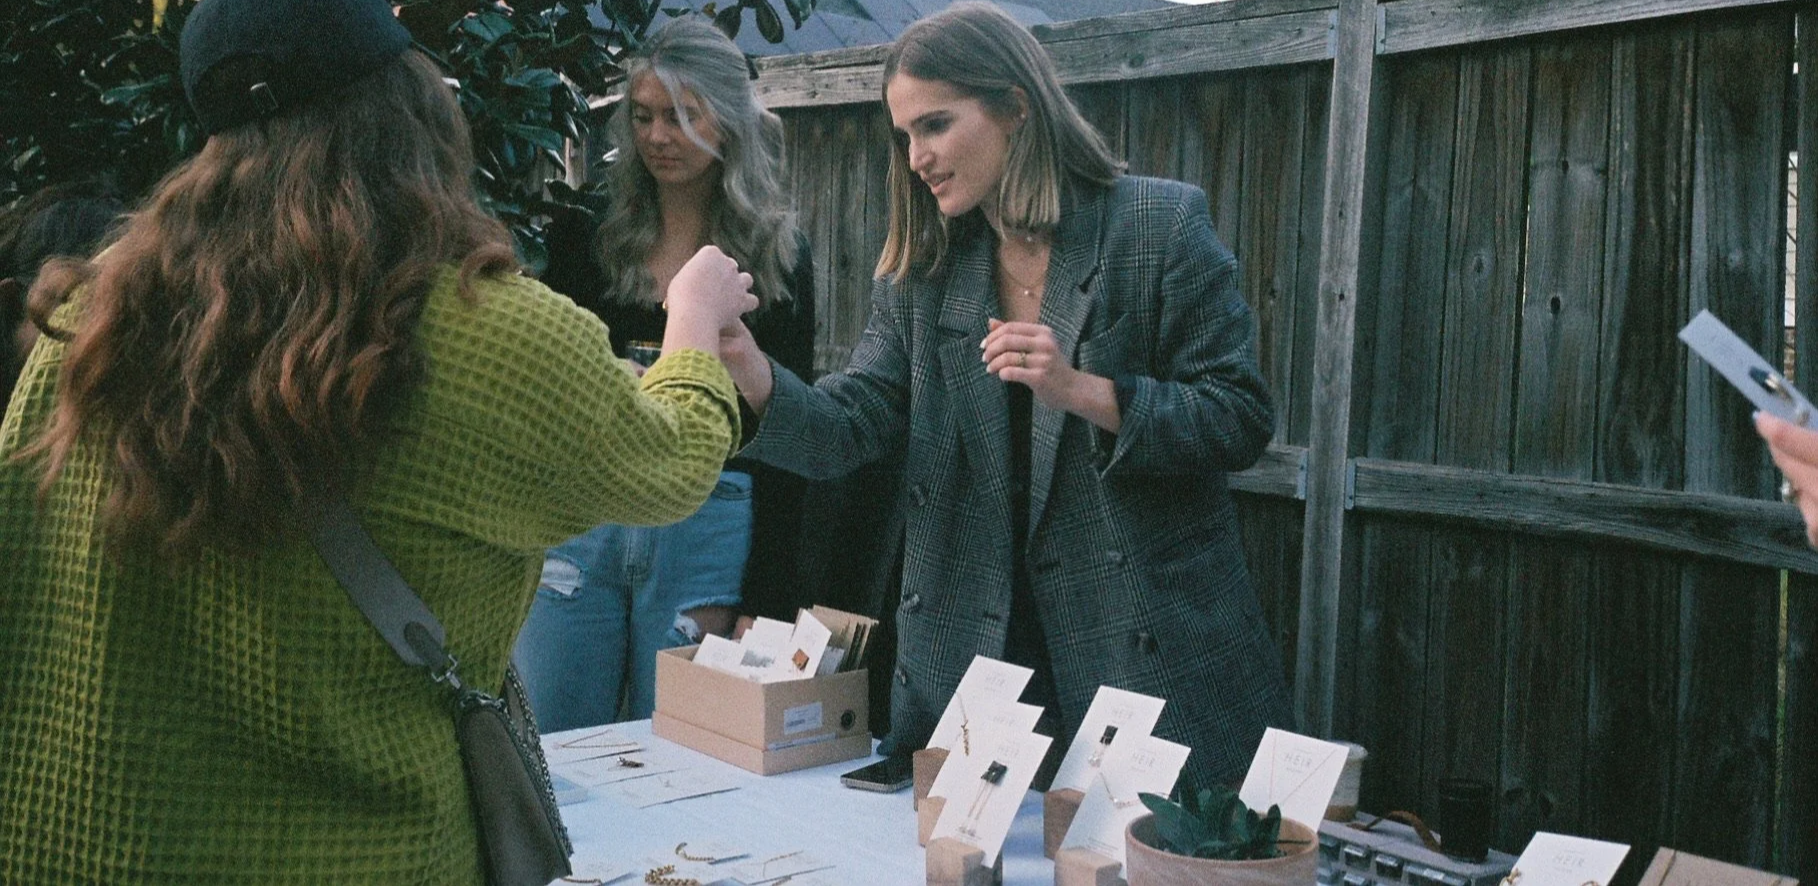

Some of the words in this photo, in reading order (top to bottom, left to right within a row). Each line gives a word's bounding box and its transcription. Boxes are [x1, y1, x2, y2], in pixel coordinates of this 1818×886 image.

[1132, 752, 1156, 768] HEIR
[1284, 753, 1312, 767] HEIR
[1552, 854, 1585, 867] HEIR
